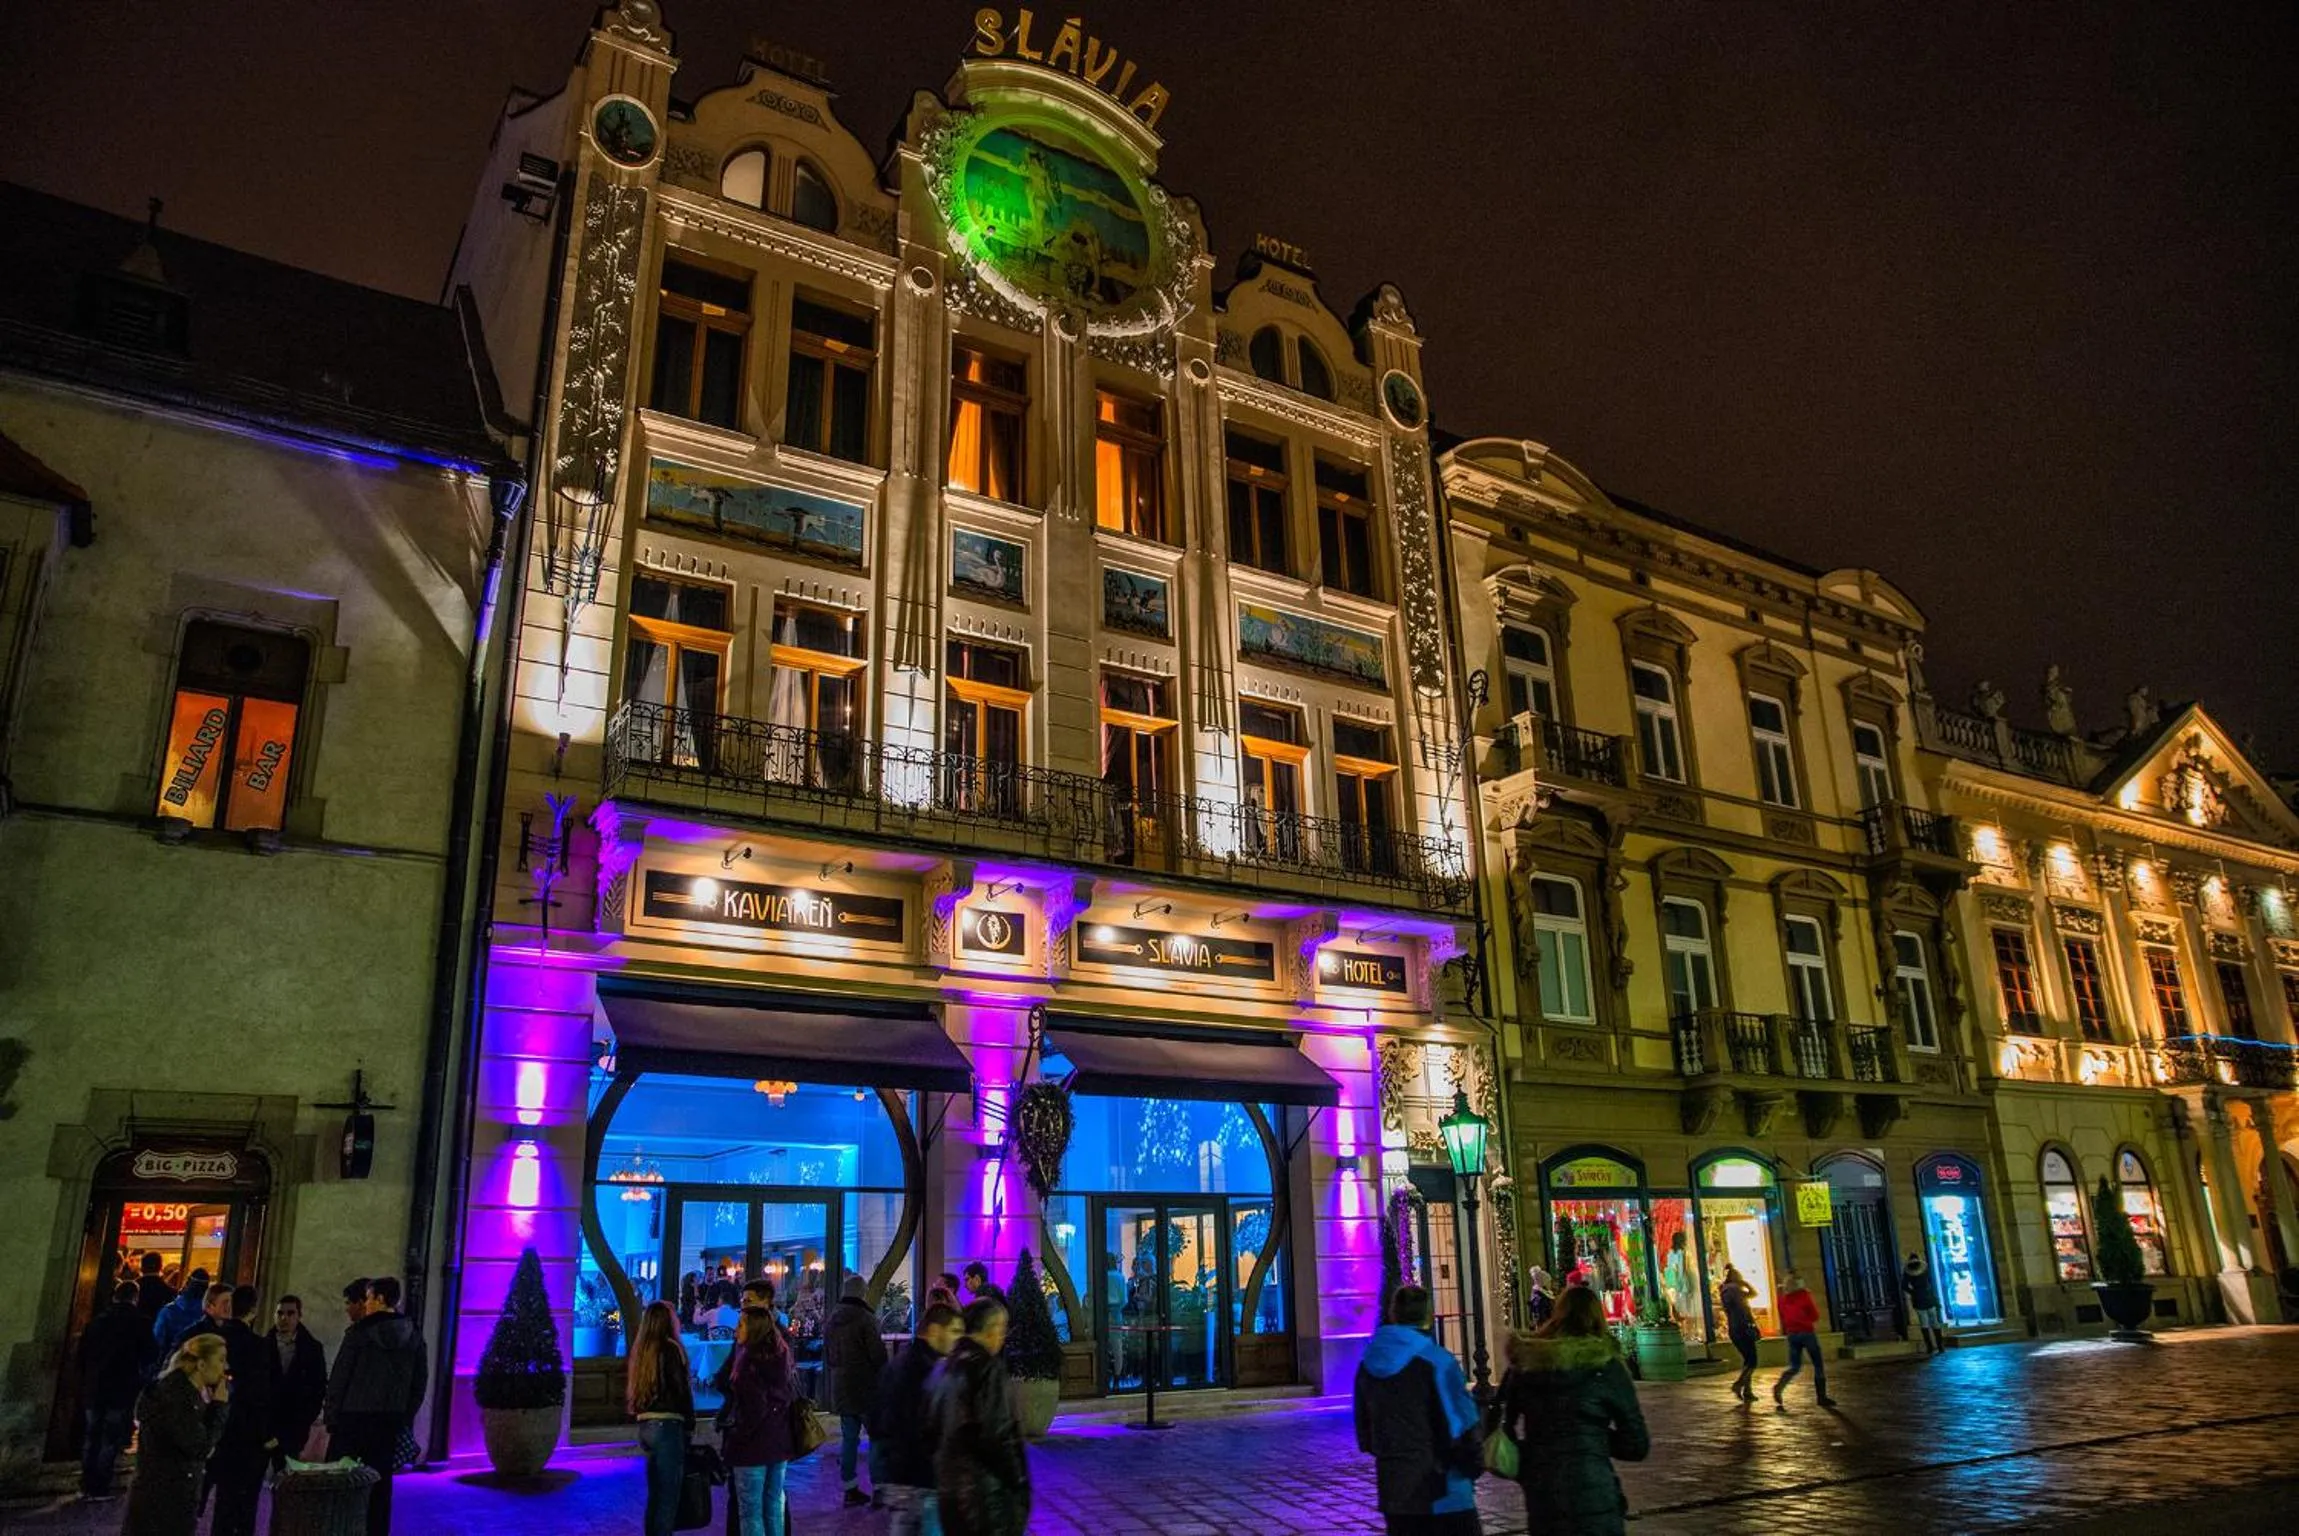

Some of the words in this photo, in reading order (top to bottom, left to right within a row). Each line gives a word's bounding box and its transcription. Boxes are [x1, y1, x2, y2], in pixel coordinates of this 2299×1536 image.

[974, 7, 1171, 131] SLÁVIA
[164, 708, 227, 807] BILIARD
[247, 740, 286, 792] BAR
[1343, 958, 1387, 985] HOTEL
[145, 1160, 172, 1171] BIG
[183, 1162, 226, 1173] PIZZA
